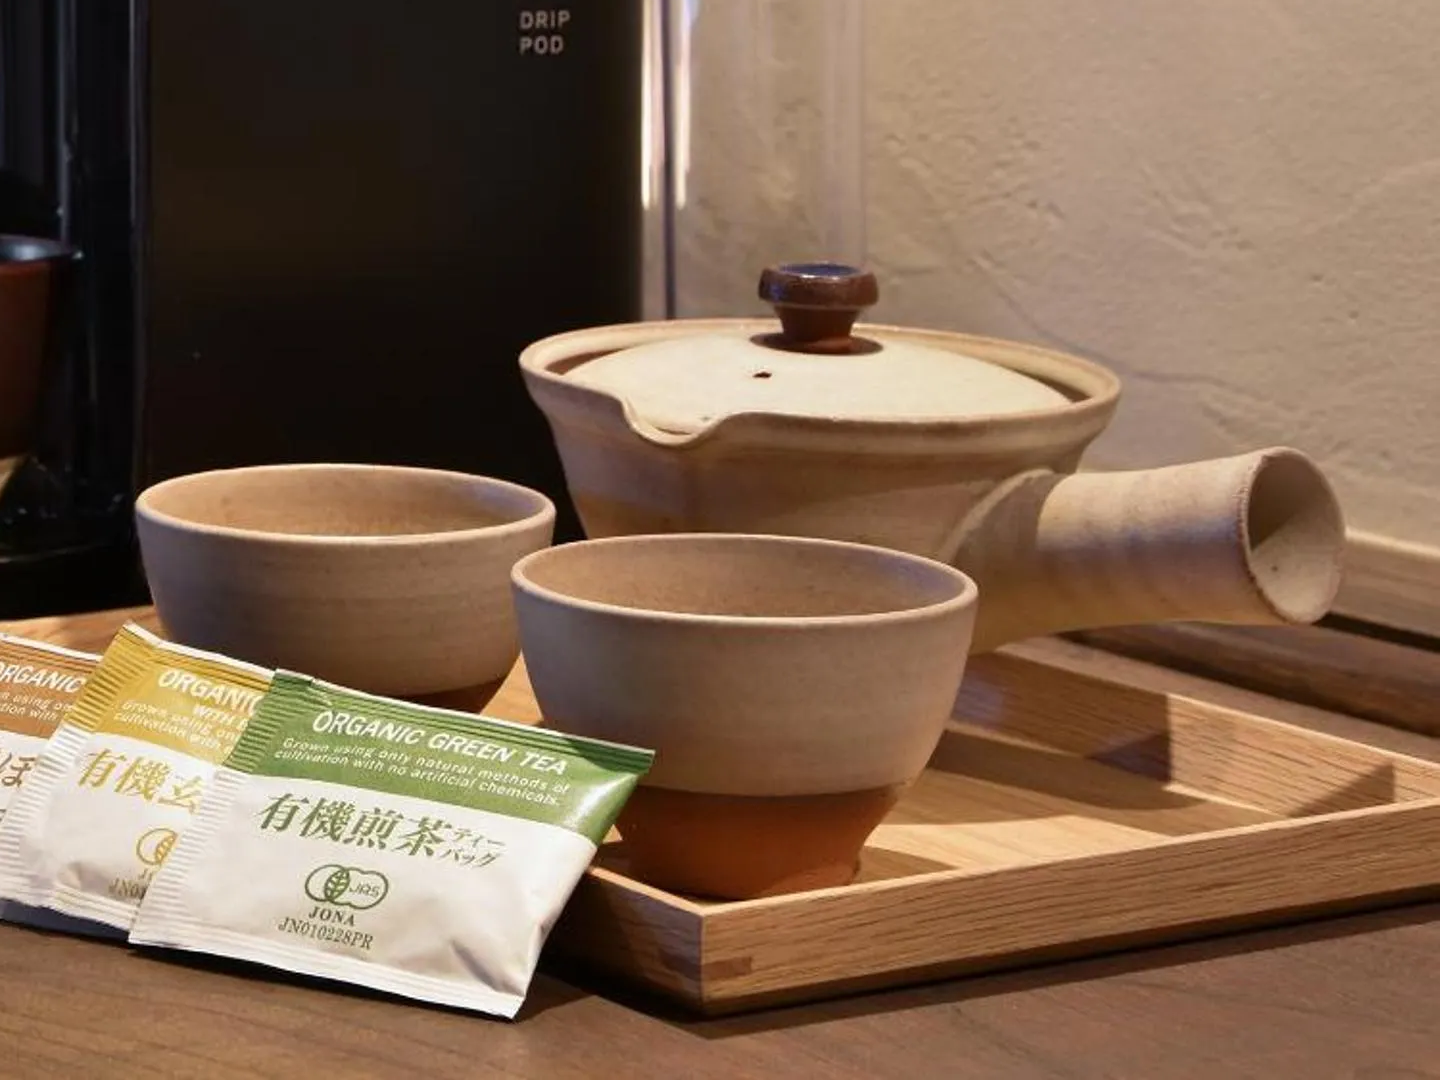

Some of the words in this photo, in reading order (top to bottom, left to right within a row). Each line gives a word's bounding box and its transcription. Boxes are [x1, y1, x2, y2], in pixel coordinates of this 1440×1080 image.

[520, 10, 571, 30] DRIP
[520, 35, 565, 55] POD
[12, 694, 51, 711] using
[29, 708, 60, 722] with
[192, 704, 236, 728] WITH
[313, 711, 426, 745] ORGANIC
[428, 733, 516, 763] GREEN
[519, 750, 568, 775] TEA
[274, 749, 350, 767] cultivation
[353, 759, 386, 773] with
[387, 765, 409, 776] no
[410, 767, 477, 790] artificial
[283, 737, 330, 753] Grown
[334, 745, 376, 759] using
[378, 750, 411, 765] only
[416, 756, 473, 776] natural
[477, 769, 549, 792] methods
[551, 783, 572, 795] of
[79, 748, 203, 814] 有機玄
[257, 792, 453, 857] 有機煎茶
[452, 825, 507, 849] ティー
[348, 882, 380, 898] JAS
[308, 906, 356, 928] JONA
[277, 916, 375, 951] JN010228PR
